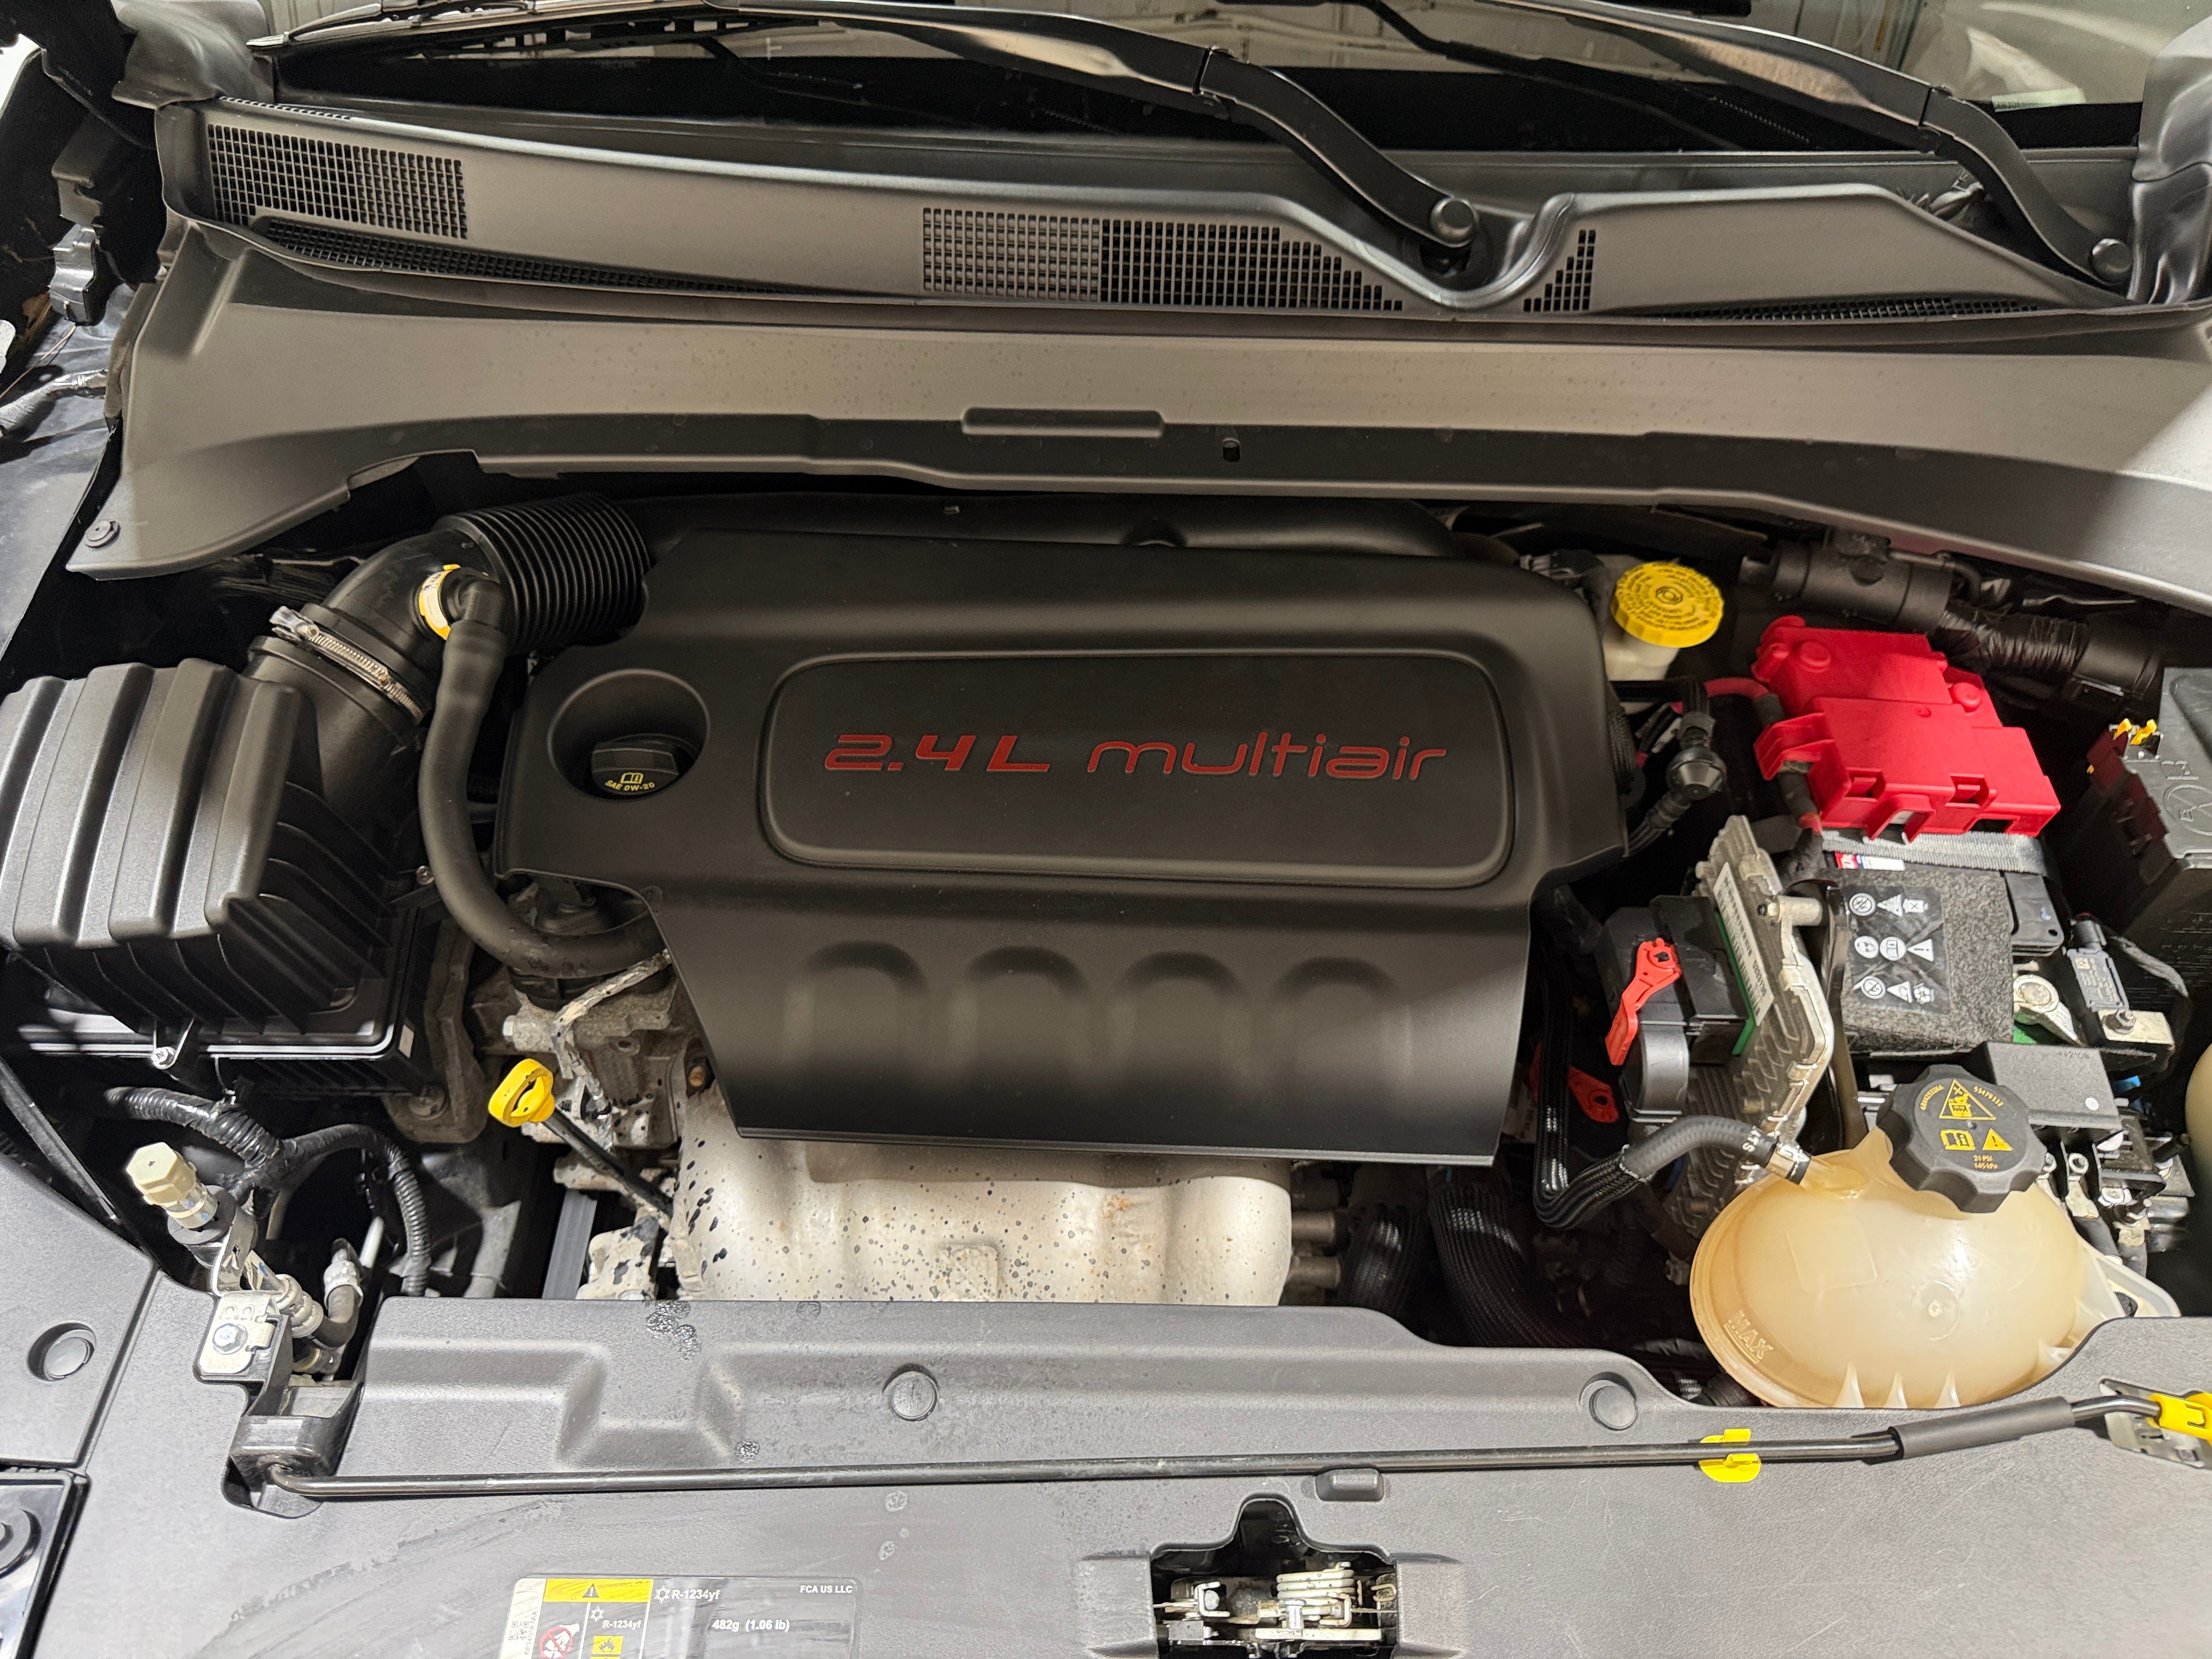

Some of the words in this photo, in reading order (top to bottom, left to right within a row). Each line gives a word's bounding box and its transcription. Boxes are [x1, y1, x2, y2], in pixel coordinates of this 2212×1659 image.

[1087, 731, 1447, 780] multiair
[605, 780, 622, 790] SAE
[624, 782, 655, 791] 0W-20
[1728, 1310, 1775, 1359] MAX
[672, 1589, 721, 1602] R-1234yf
[799, 1584, 819, 1594] FCA
[820, 1585, 833, 1594] US
[835, 1585, 853, 1594] LLC
[602, 1619, 642, 1630] R-1234yf
[712, 1619, 740, 1633] 482g
[745, 1619, 773, 1633] (1.06
[775, 1619, 791, 1633] lb)
